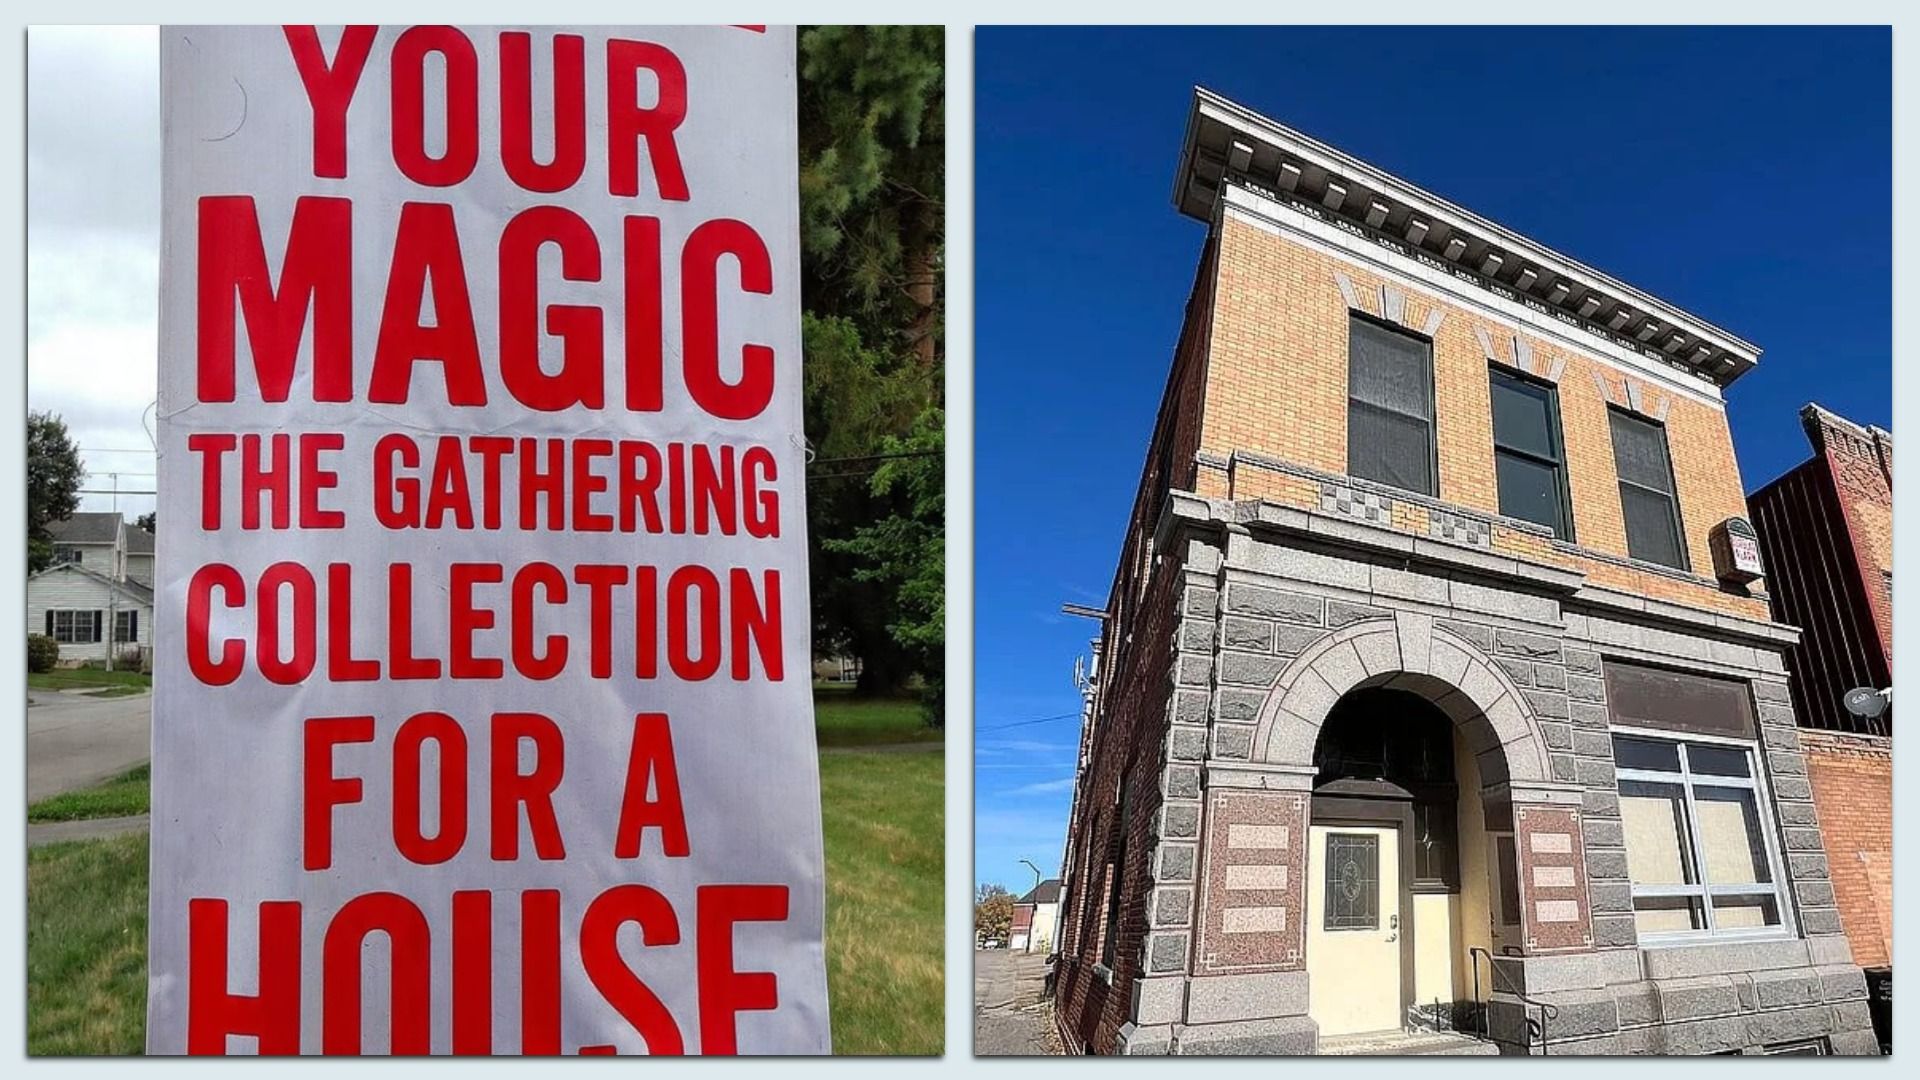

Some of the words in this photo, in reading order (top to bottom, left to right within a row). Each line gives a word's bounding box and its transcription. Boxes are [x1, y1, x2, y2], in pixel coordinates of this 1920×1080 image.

[282, 25, 689, 201] YOUR
[196, 195, 774, 420] MAGIC
[189, 433, 344, 531] THE
[374, 433, 779, 539] GATHERING
[185, 561, 783, 685] COLLECTION
[304, 712, 564, 870] FOR
[615, 713, 689, 858] A
[188, 885, 789, 1055] HOUSE
